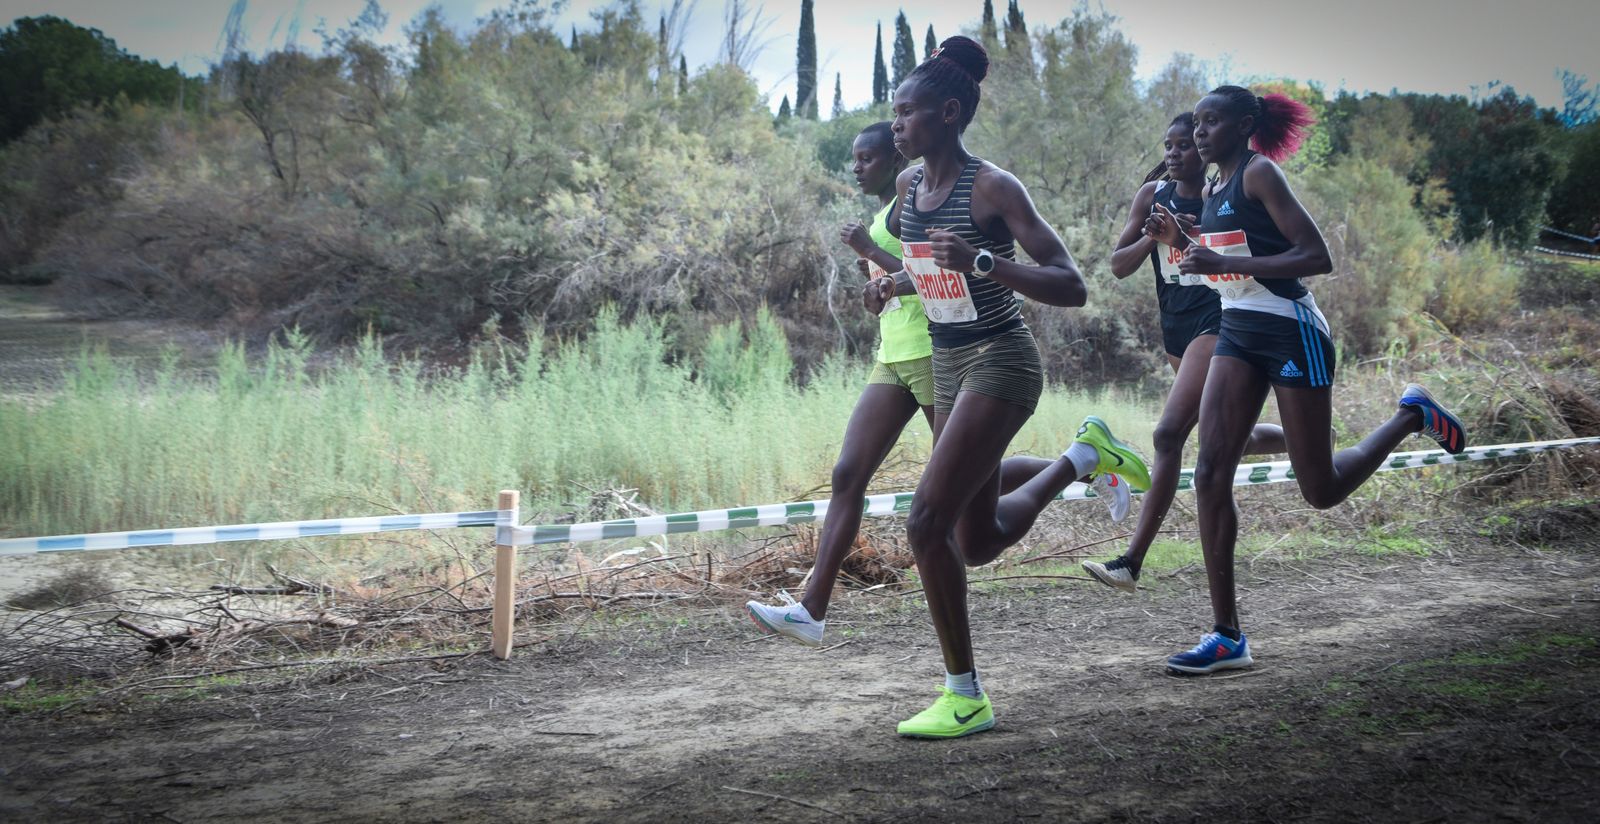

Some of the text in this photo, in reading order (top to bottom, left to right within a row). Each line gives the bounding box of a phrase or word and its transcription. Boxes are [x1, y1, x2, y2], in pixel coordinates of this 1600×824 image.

[1216, 207, 1235, 217] adidas
[1166, 244, 1184, 265] Je
[1279, 369, 1304, 377] adidas
